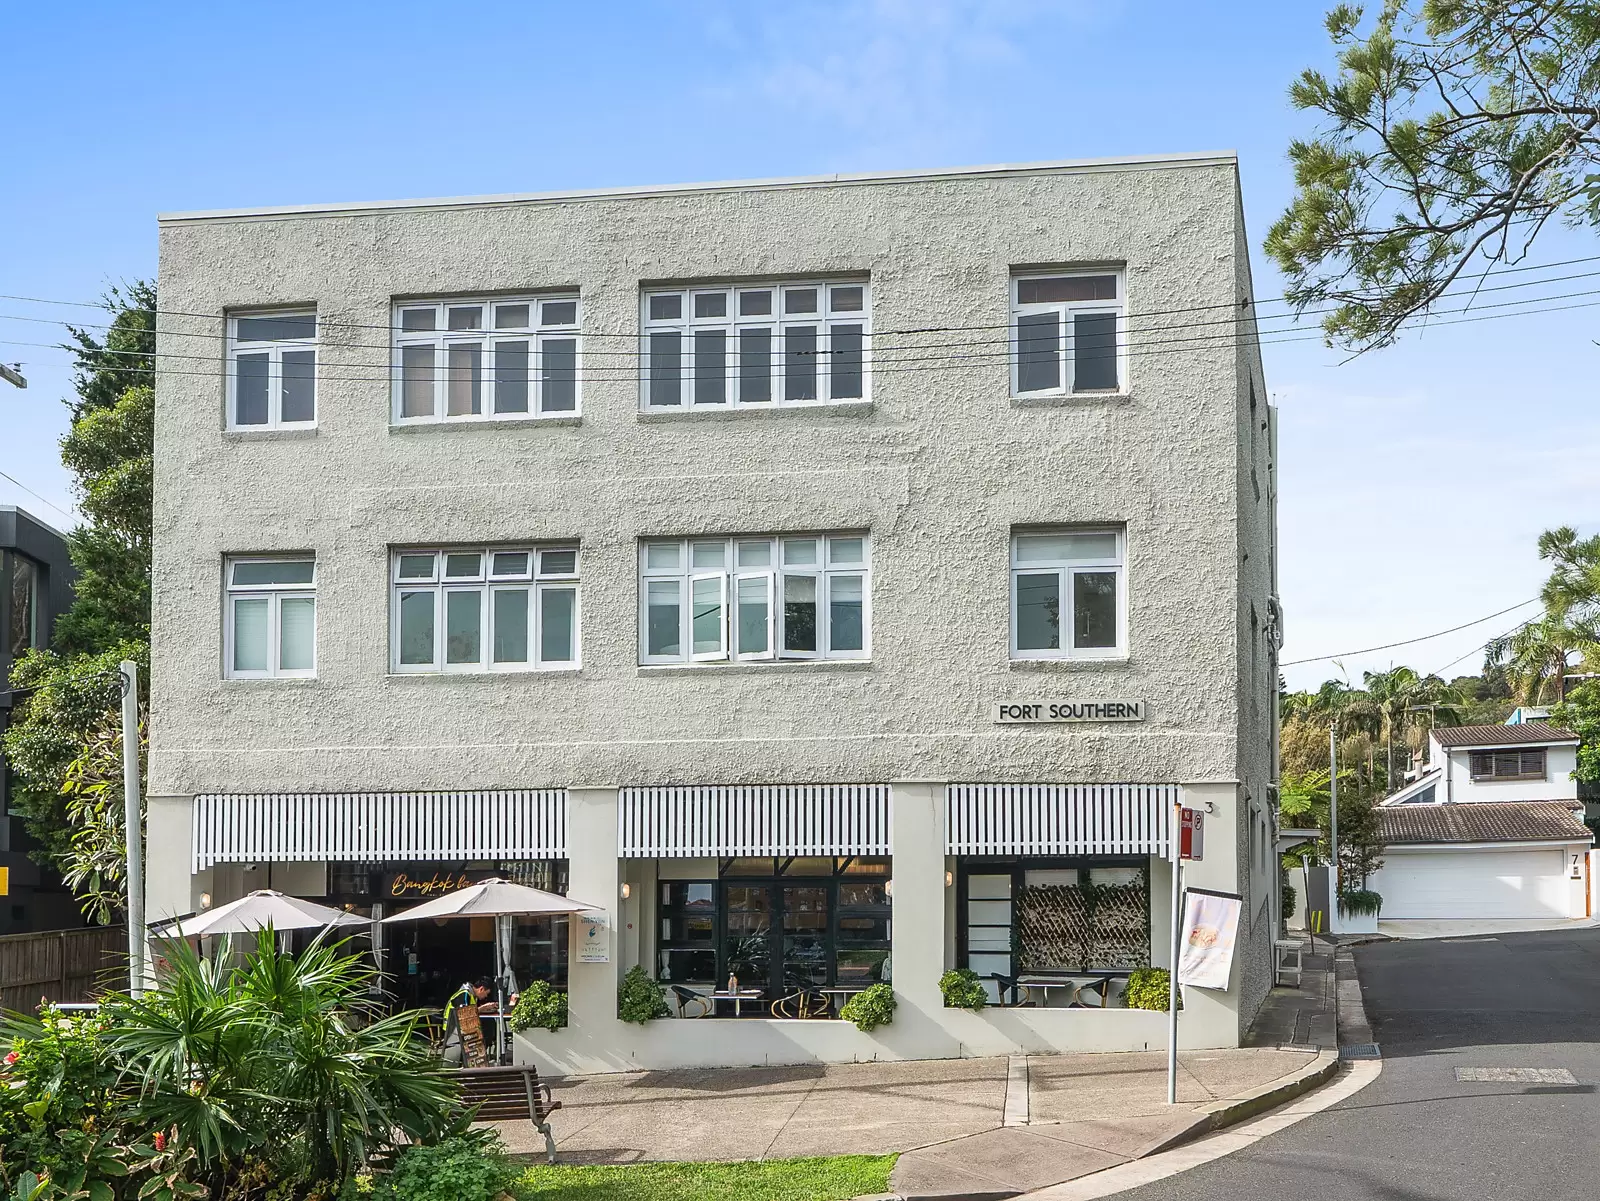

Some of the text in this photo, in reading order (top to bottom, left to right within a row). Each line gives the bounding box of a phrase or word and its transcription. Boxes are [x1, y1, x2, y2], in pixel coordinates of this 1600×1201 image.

[999, 703, 1139, 719] FORT SOUTHERN
[1204, 802, 1213, 813] 3
[1572, 854, 1579, 865] 7
[391, 872, 455, 896] Bangkok
